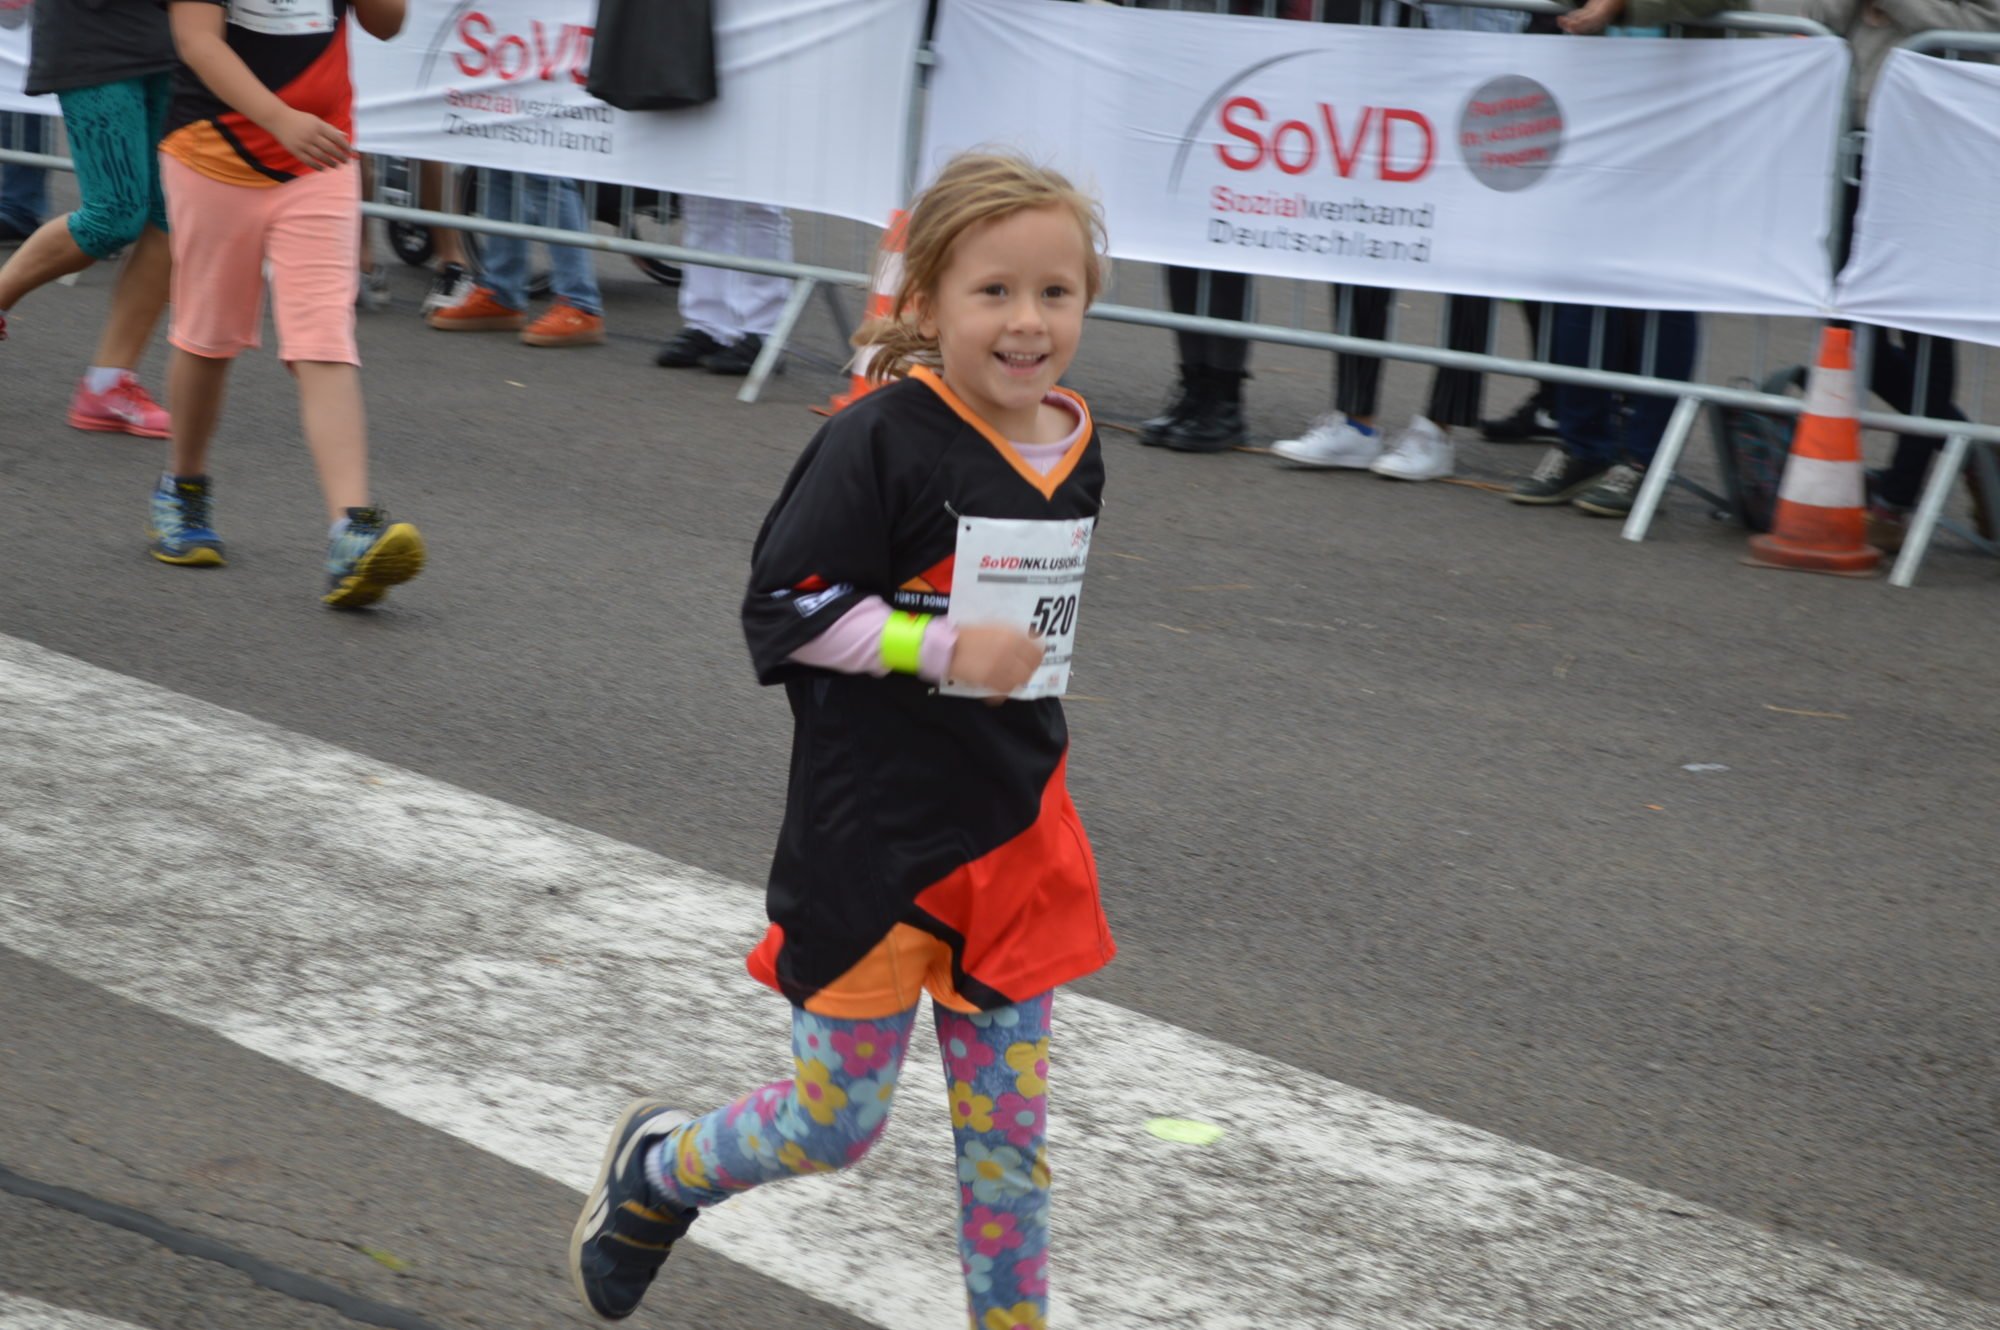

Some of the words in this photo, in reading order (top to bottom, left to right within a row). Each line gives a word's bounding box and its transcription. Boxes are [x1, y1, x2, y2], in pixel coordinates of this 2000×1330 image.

[1213, 95, 1438, 183] SoVD
[1209, 184, 1434, 229] Sozialverband
[1207, 217, 1431, 263] Deutschland
[922, 593, 950, 609] DONN
[1028, 594, 1076, 638] 520
